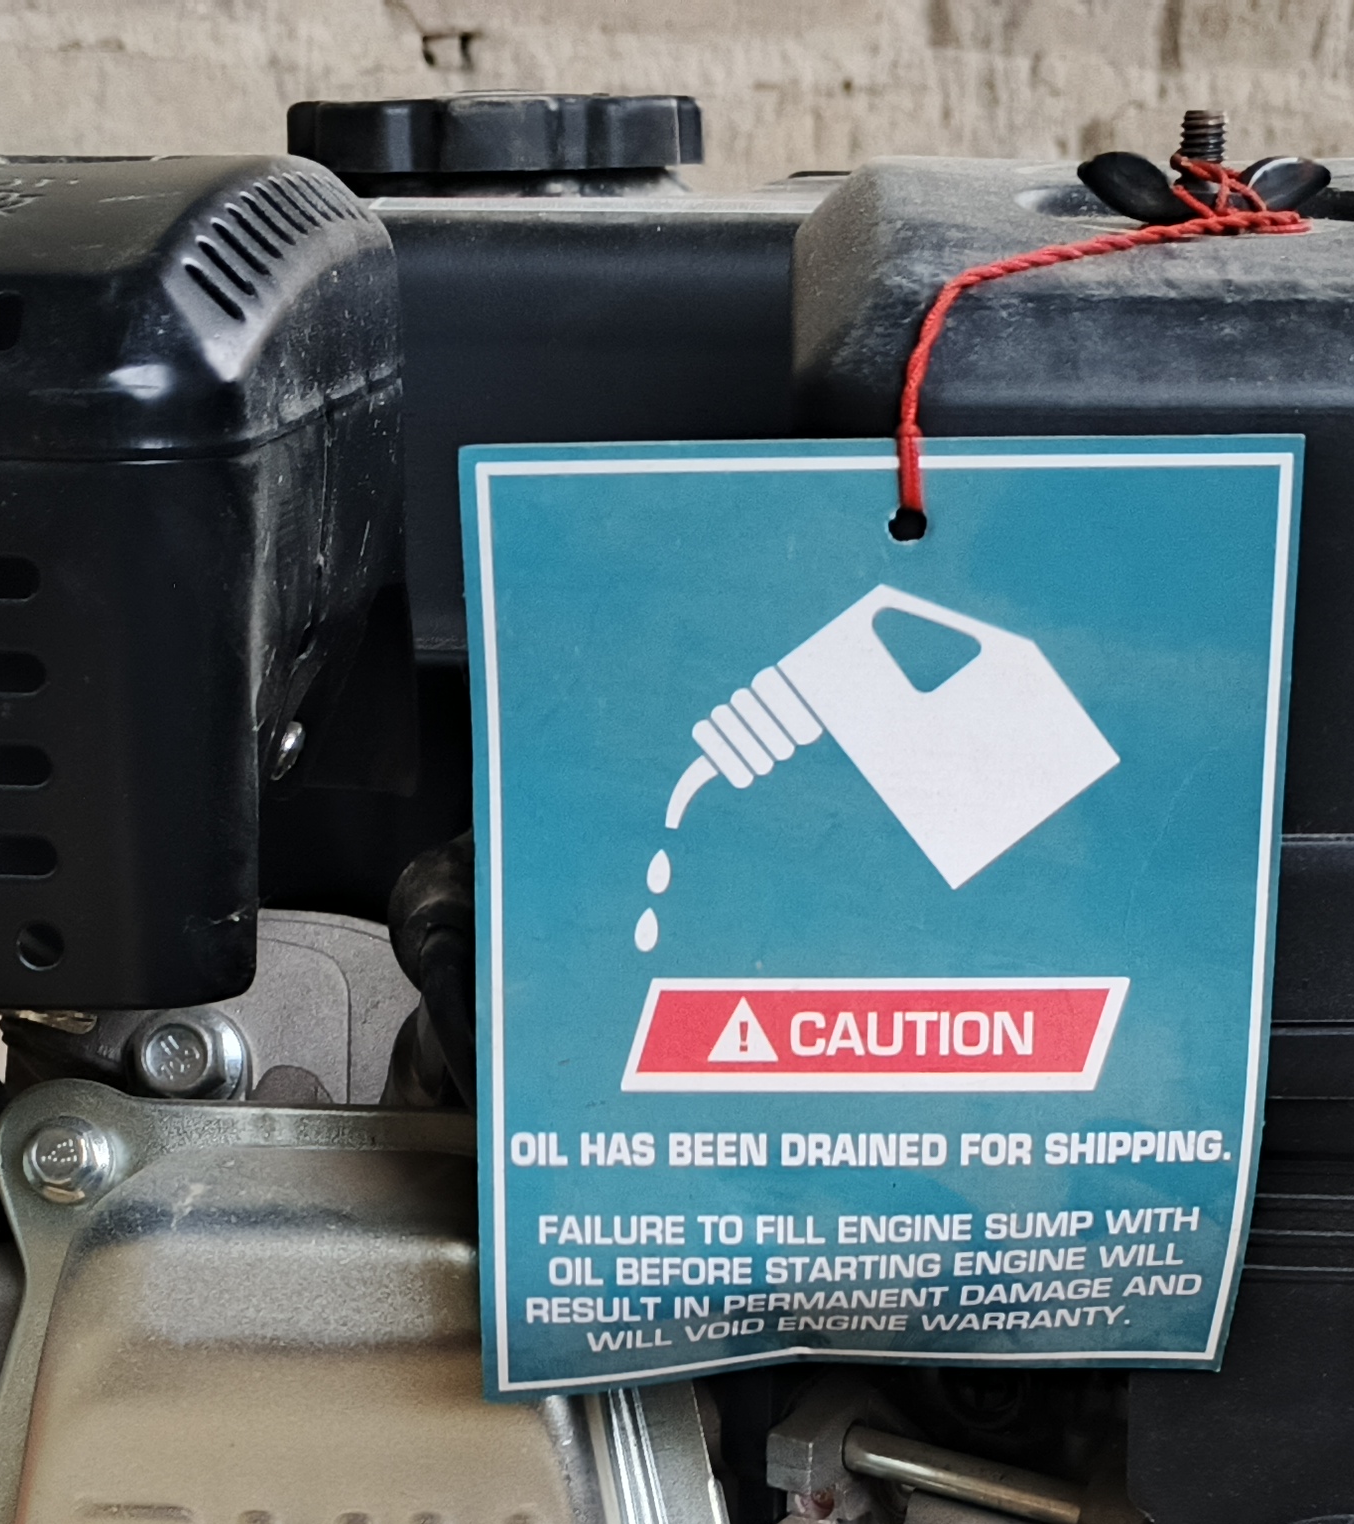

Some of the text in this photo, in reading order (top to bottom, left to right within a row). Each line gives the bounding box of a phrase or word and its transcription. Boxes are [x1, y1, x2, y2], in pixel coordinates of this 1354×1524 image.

[790, 1010, 1035, 1056] CAUTION
[510, 1130, 1232, 1167] OIL HAS BEEN DRAINED FOR SHIPPING.
[538, 1206, 1201, 1246] FAILURE TO FILL ENGINE SUMP WITH
[548, 1243, 1185, 1286] OIL BEFORE STARTING ENGINE WILL
[526, 1273, 1203, 1325] RESULT IN PERMANENT DAMAGE AND
[586, 1304, 1132, 1353] WILL VOID ENGINE WARRANTY.
